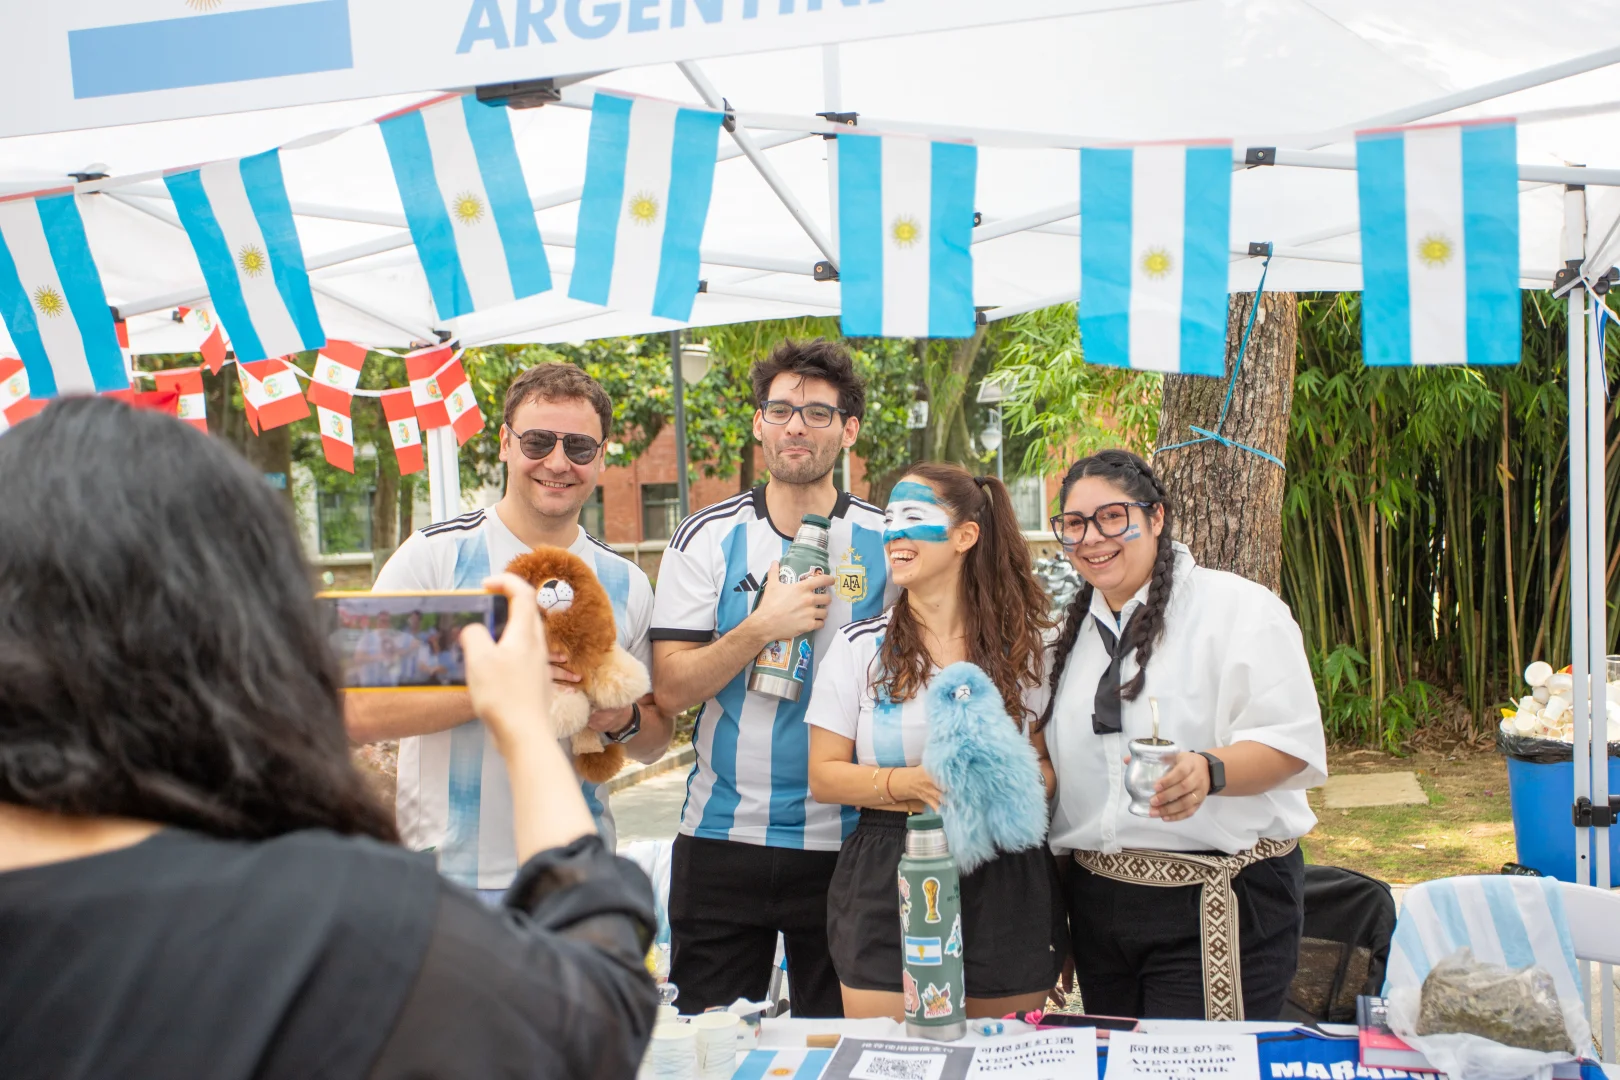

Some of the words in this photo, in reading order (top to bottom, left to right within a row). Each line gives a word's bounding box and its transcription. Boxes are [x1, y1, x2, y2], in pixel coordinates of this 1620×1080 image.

[842, 574, 861, 592] AFA
[1021, 1057, 1067, 1067] Wine
[1128, 1057, 1237, 1067] Argentinian
